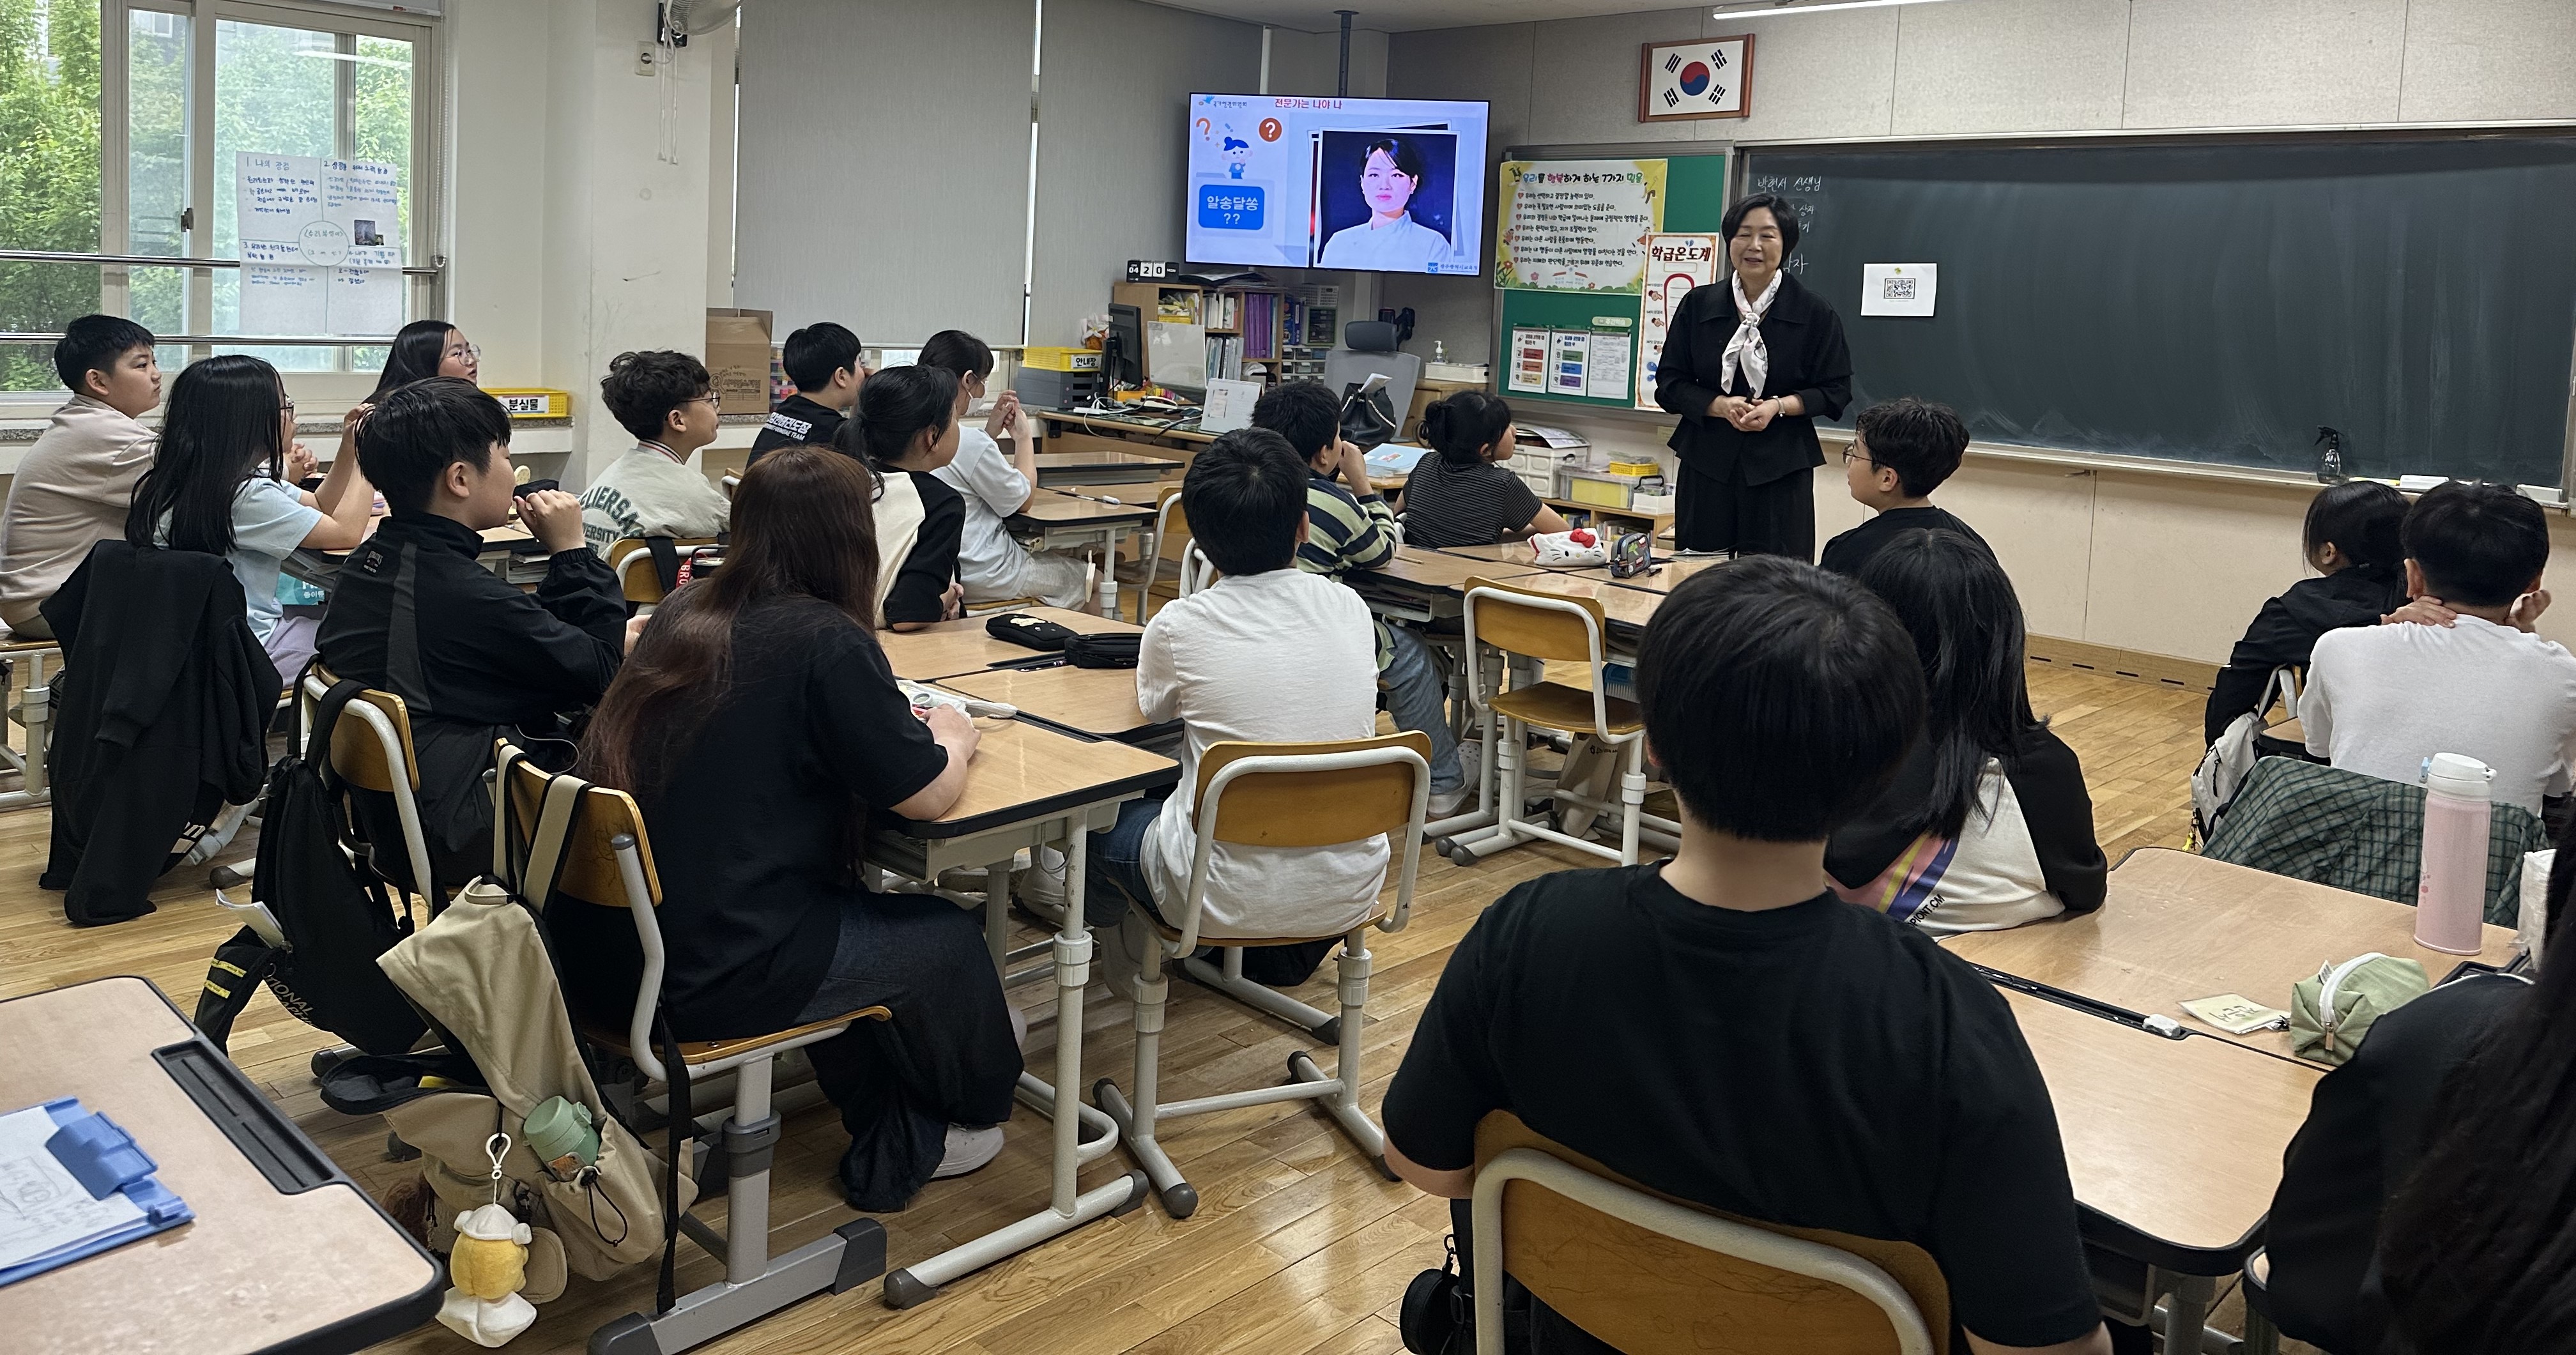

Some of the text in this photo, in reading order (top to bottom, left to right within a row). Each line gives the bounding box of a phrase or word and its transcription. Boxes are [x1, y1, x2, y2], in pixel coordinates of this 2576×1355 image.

[1275, 98, 1342, 110] 전문가는 나야 나
[255, 158, 270, 168] 나의
[1522, 172, 1643, 184] 우리를 행복하게 하는 7가지 믿음
[1758, 175, 1821, 193] 박현서 선생님
[1207, 195, 1259, 211] 알송달쏭
[1798, 203, 1814, 216] 상자
[1223, 213, 1241, 225] ??
[1651, 245, 1712, 262] 학급온도계
[1075, 357, 1096, 367] 안내장
[509, 398, 539, 411] 분실물
[790, 431, 806, 441] TEAM
